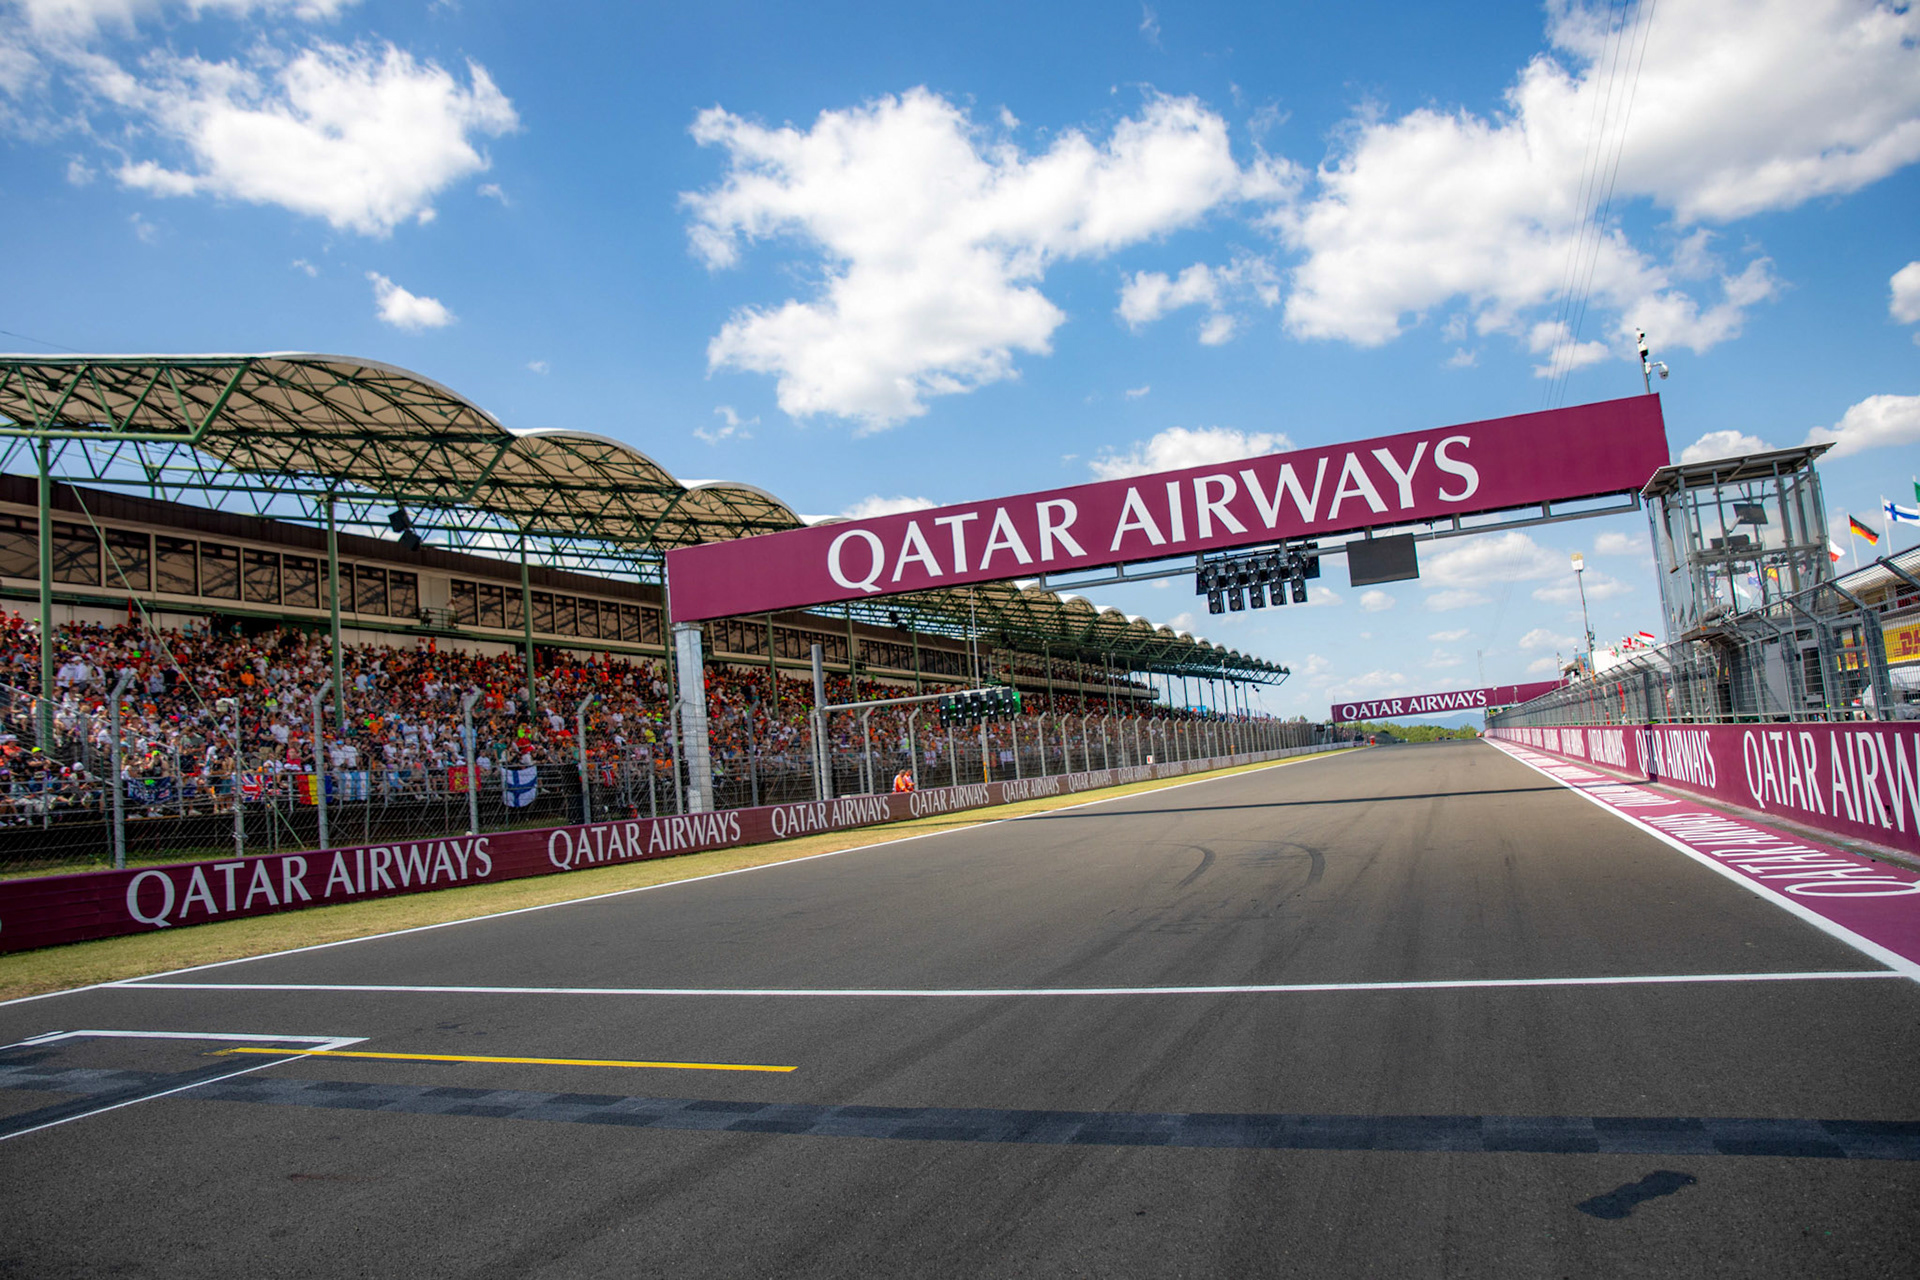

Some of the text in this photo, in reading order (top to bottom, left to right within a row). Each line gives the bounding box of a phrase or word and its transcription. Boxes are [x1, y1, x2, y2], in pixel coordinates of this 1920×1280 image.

[827, 436, 1480, 593] QATAR AIRWAYS
[1342, 690, 1487, 720] QATAR AIRWAYS
[1635, 730, 1667, 778] QATAR
[1664, 730, 1717, 789] AIRWAYS
[1743, 730, 1827, 815] QATAR
[771, 795, 891, 839] QATAR AIRWAYS
[910, 783, 990, 817] QATAR AIRWAYS
[1002, 776, 1060, 803] QATAR AIRWAYS
[548, 811, 742, 871] QATAR AIRWAYS
[126, 836, 494, 928] QATAR AIRWAYS
[1710, 845, 1920, 898] QATAR
